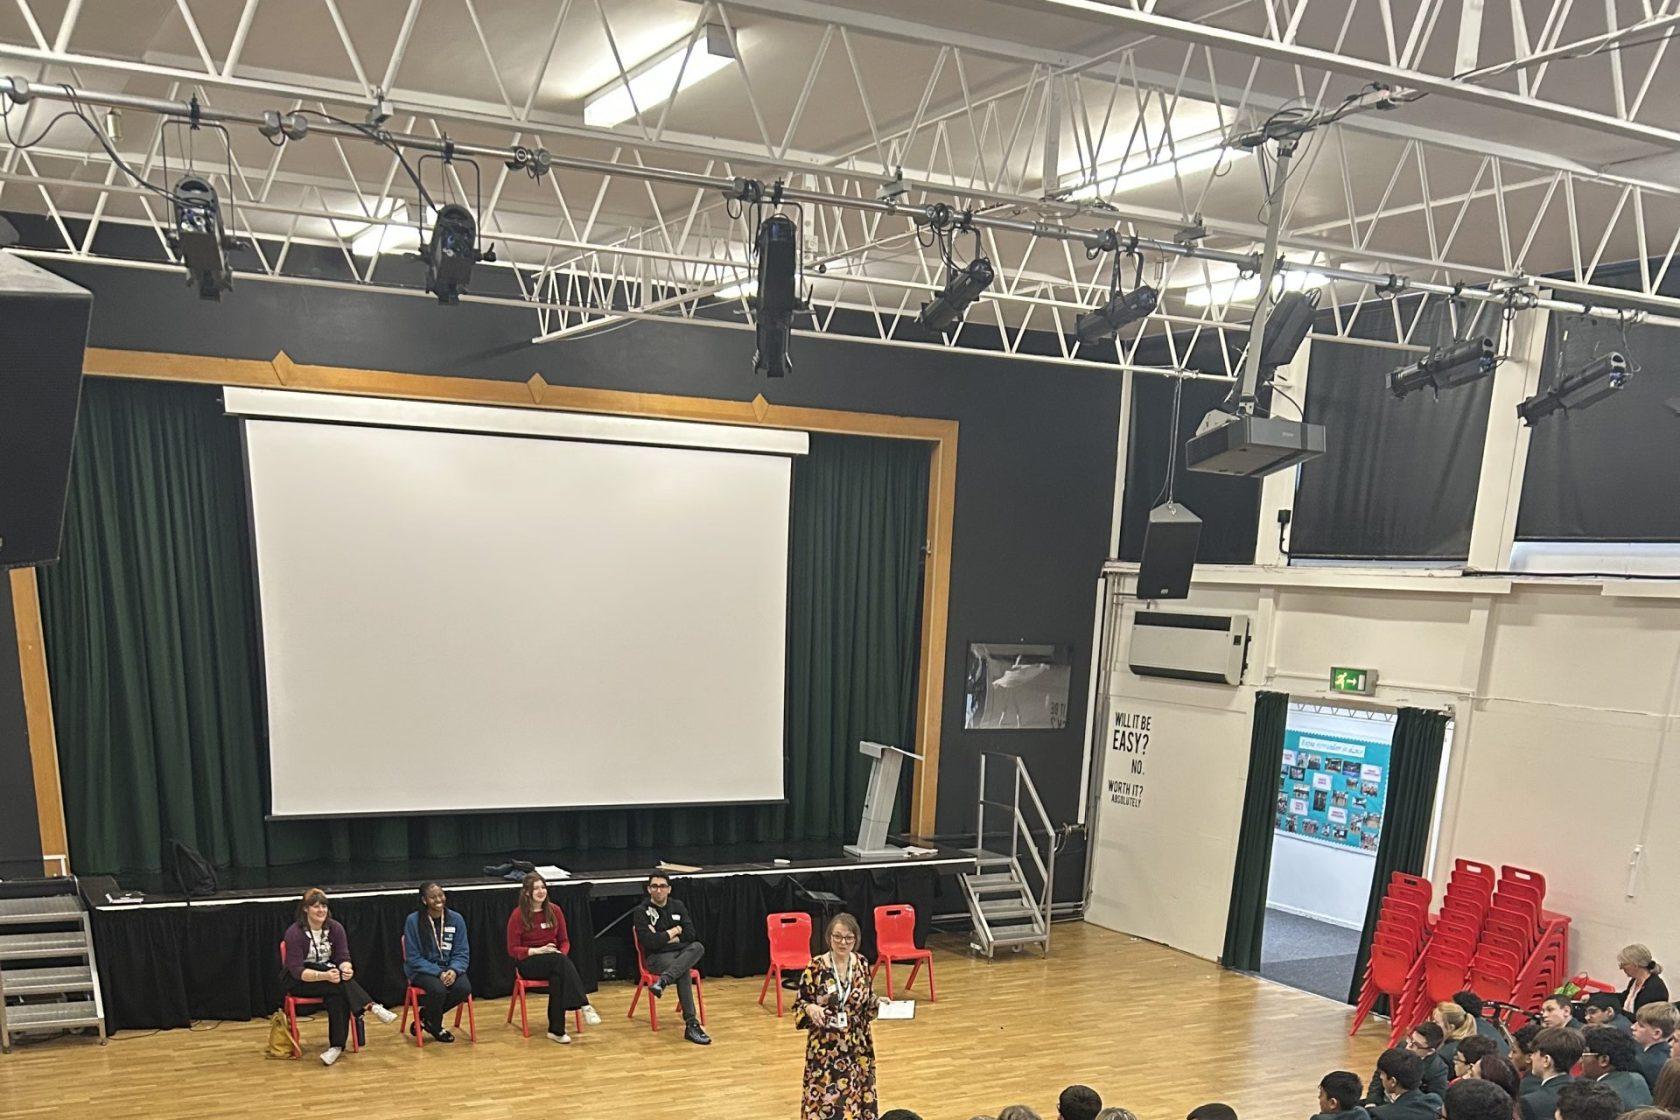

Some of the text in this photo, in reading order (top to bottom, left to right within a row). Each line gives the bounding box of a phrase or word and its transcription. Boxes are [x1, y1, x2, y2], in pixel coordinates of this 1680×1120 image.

[1115, 712, 1152, 731] WILL IT BE
[1113, 729, 1149, 755] EASY?
[1131, 759, 1145, 775] NO.
[1108, 780, 1144, 798] WORTH IT?
[1111, 794, 1142, 808] ABSOLUTELY
